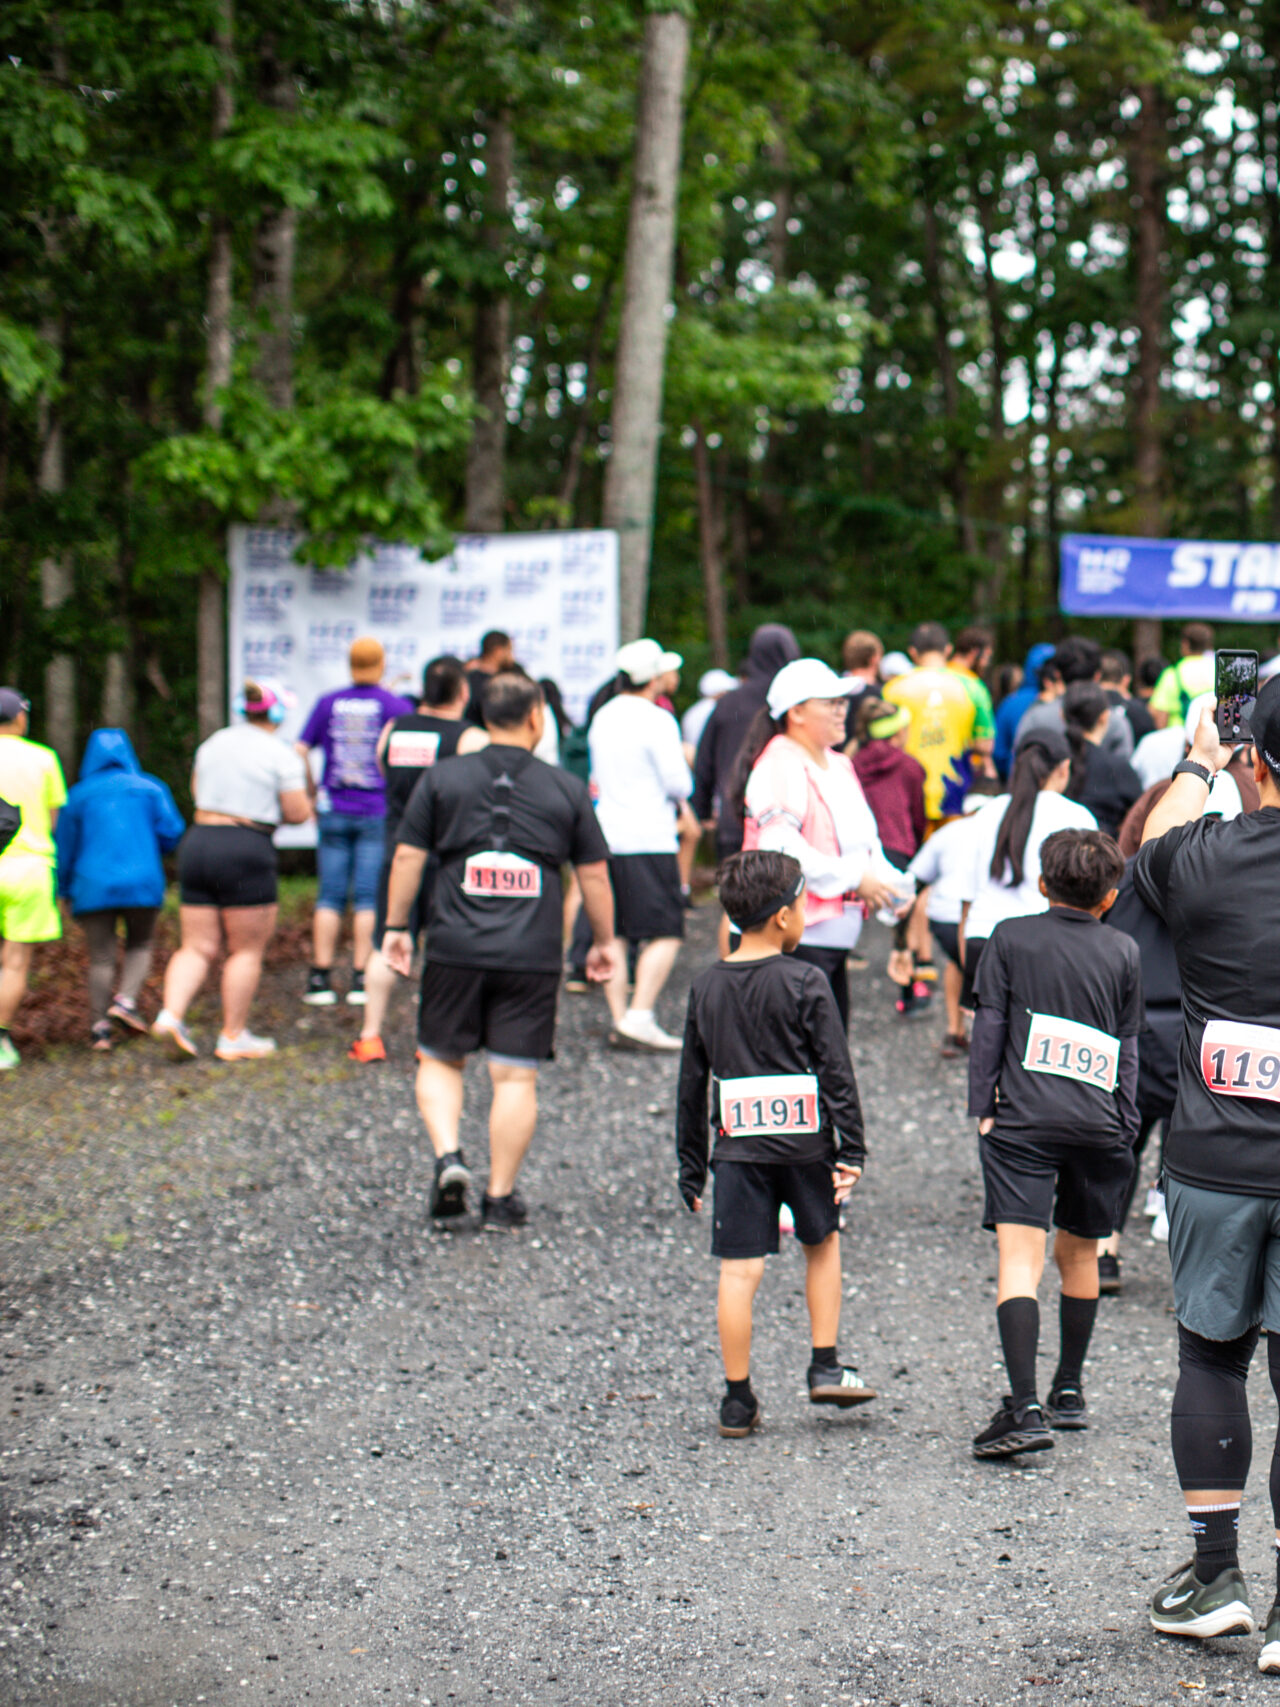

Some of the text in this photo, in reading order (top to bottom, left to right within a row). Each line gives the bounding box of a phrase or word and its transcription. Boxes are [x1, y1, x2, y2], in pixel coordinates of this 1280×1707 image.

[475, 869, 531, 890] 1190
[1036, 1038, 1108, 1081] 1192
[731, 1098, 809, 1128] 1191
